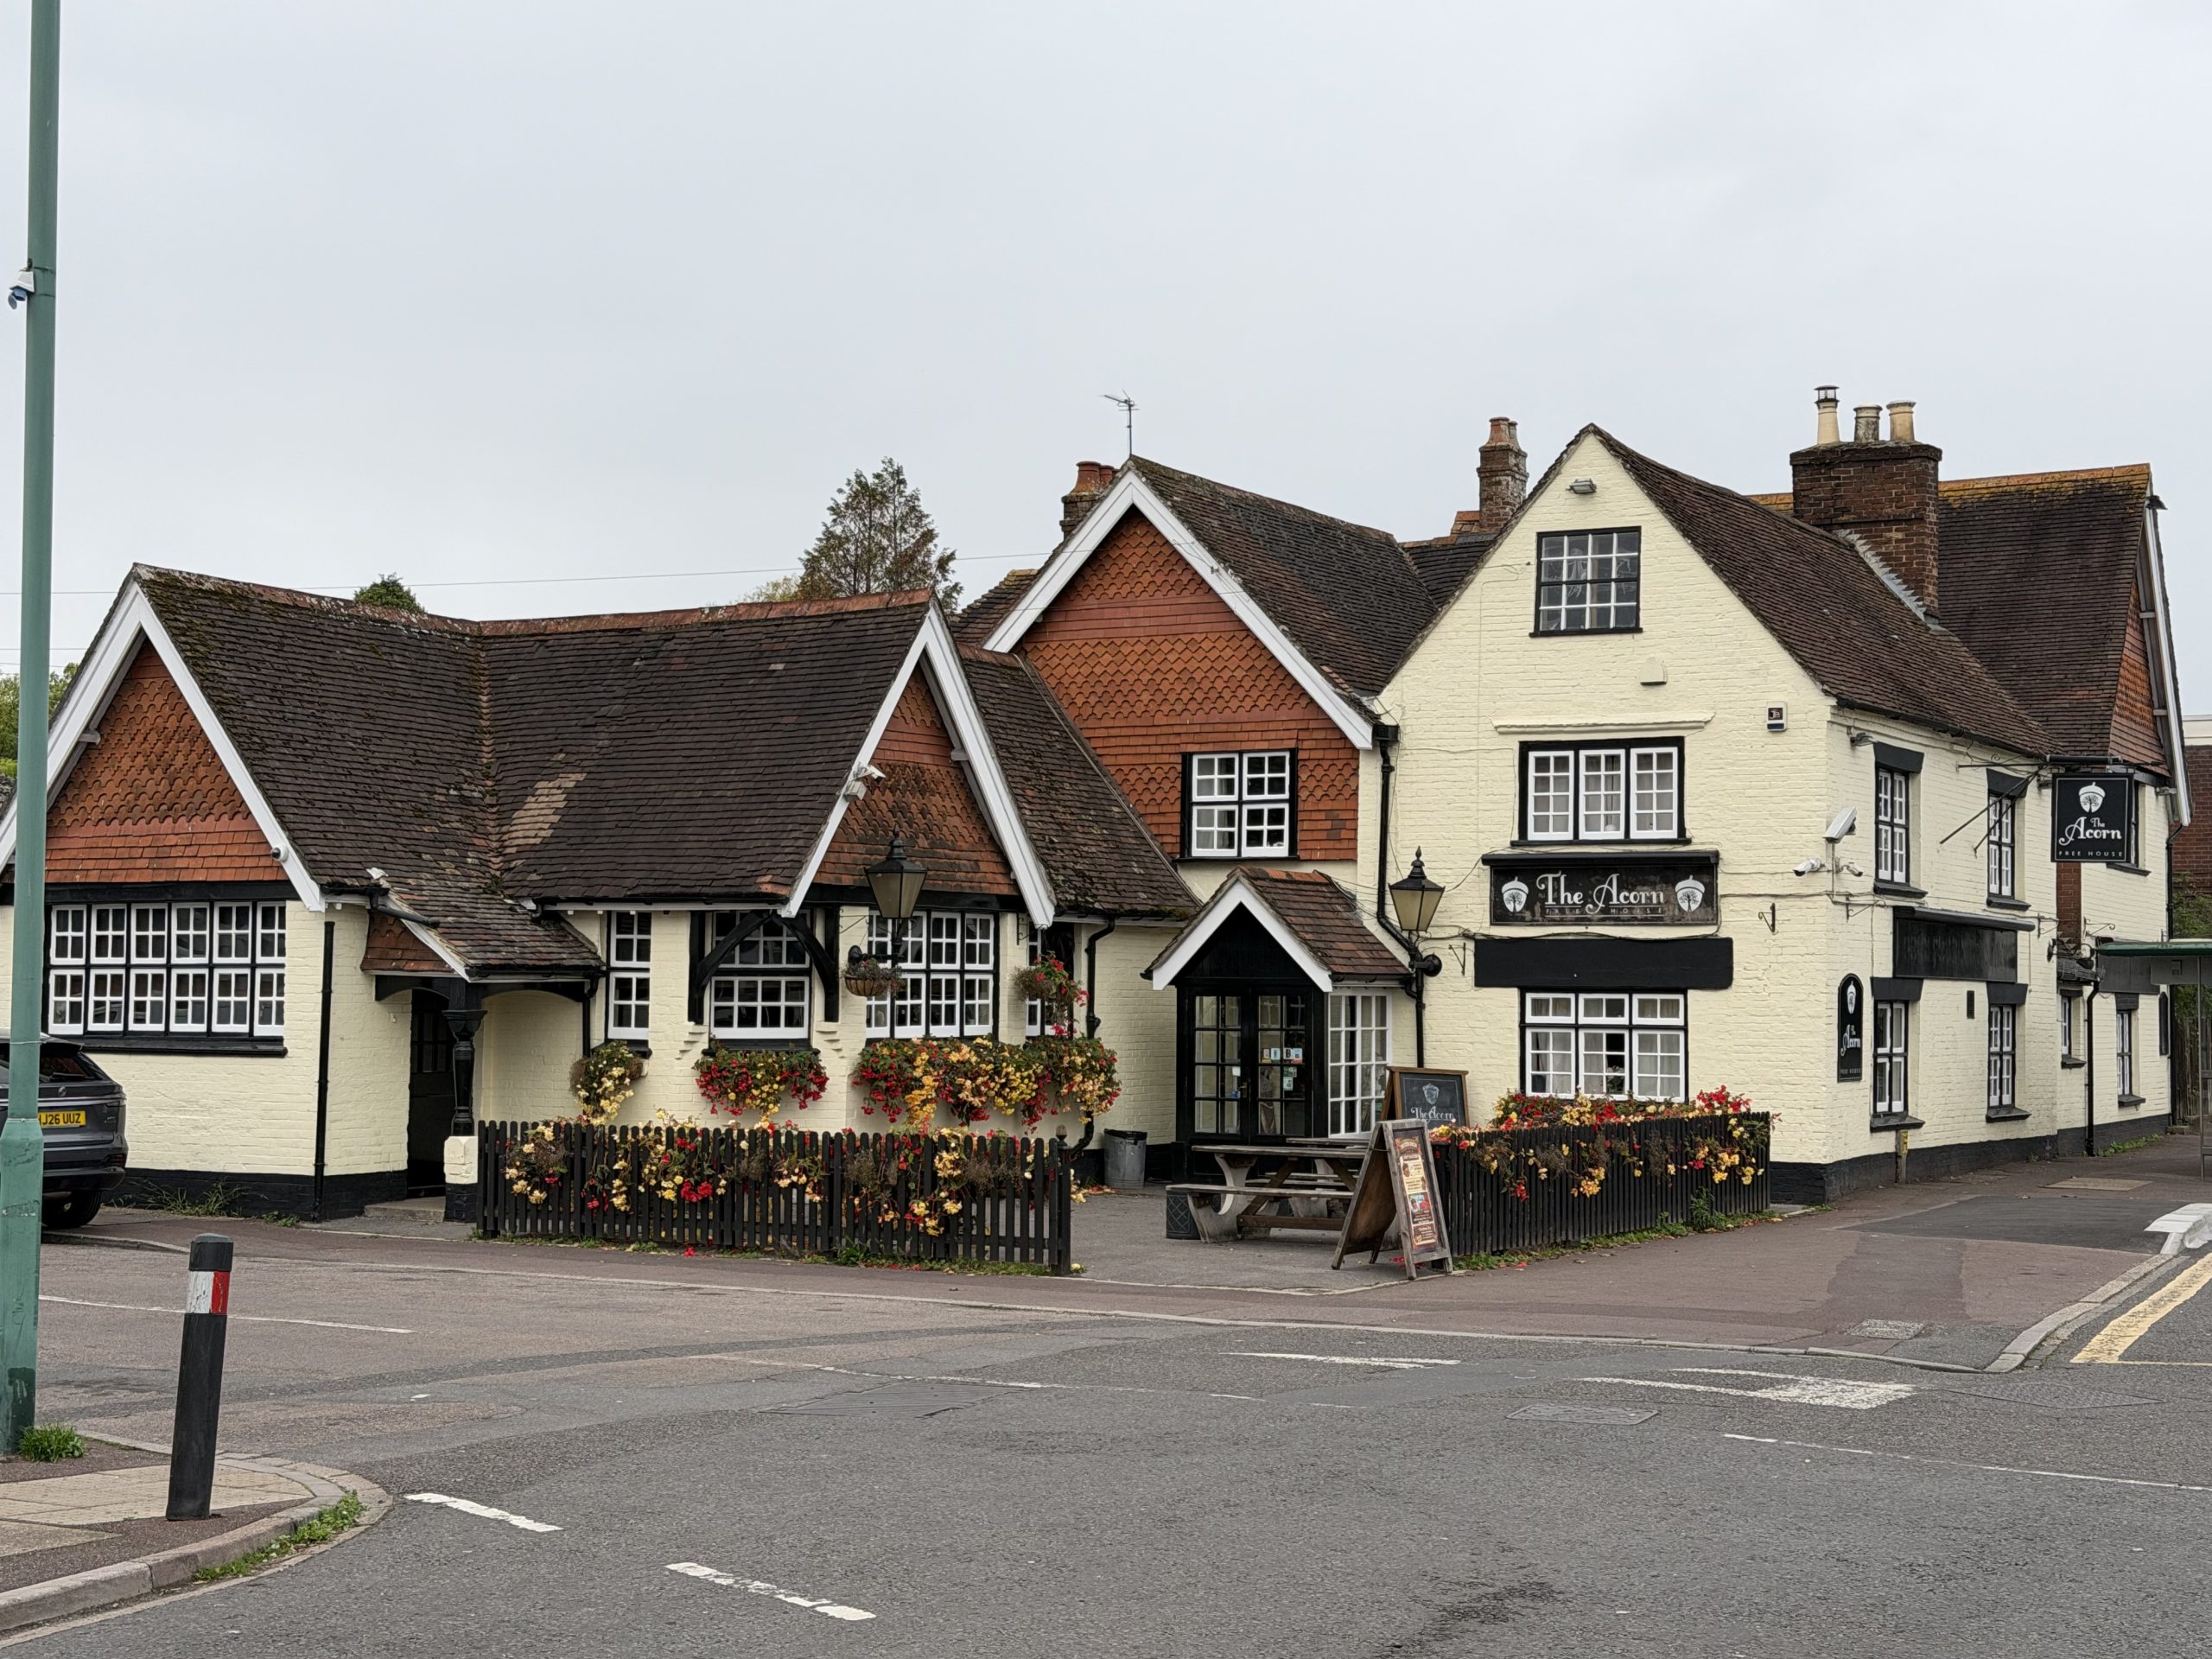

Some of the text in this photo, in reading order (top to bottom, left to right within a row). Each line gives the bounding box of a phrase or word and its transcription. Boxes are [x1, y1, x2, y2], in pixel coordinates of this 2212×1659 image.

[2090, 817, 2105, 828] The
[2058, 817, 2122, 846] Acorn
[1536, 870, 1664, 915] The Acorn
[39, 1113, 81, 1125] J26 UUZ
[1411, 1107, 1427, 1119] The
